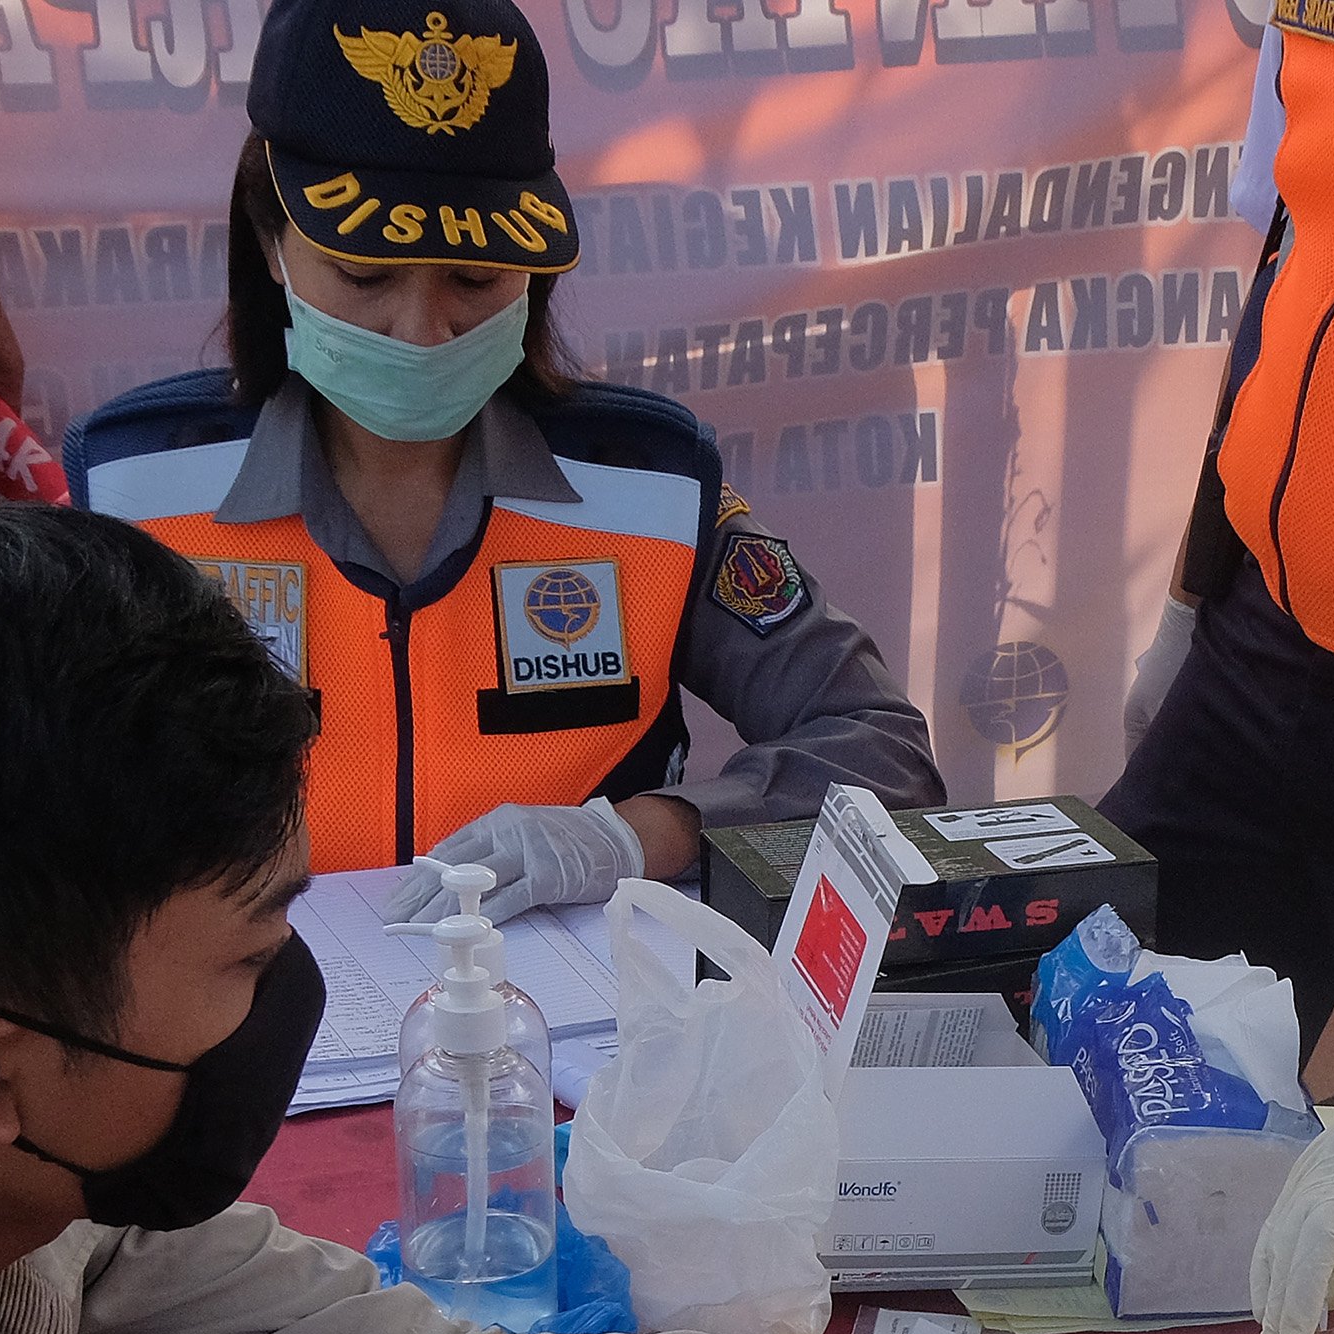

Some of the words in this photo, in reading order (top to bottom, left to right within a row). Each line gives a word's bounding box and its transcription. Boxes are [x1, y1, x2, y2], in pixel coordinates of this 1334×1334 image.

[303, 172, 567, 252] DISHUB
[513, 651, 624, 682] DISHUB
[1169, 1030, 1186, 1054] Soft
[838, 1181, 897, 1196] Wondfo
